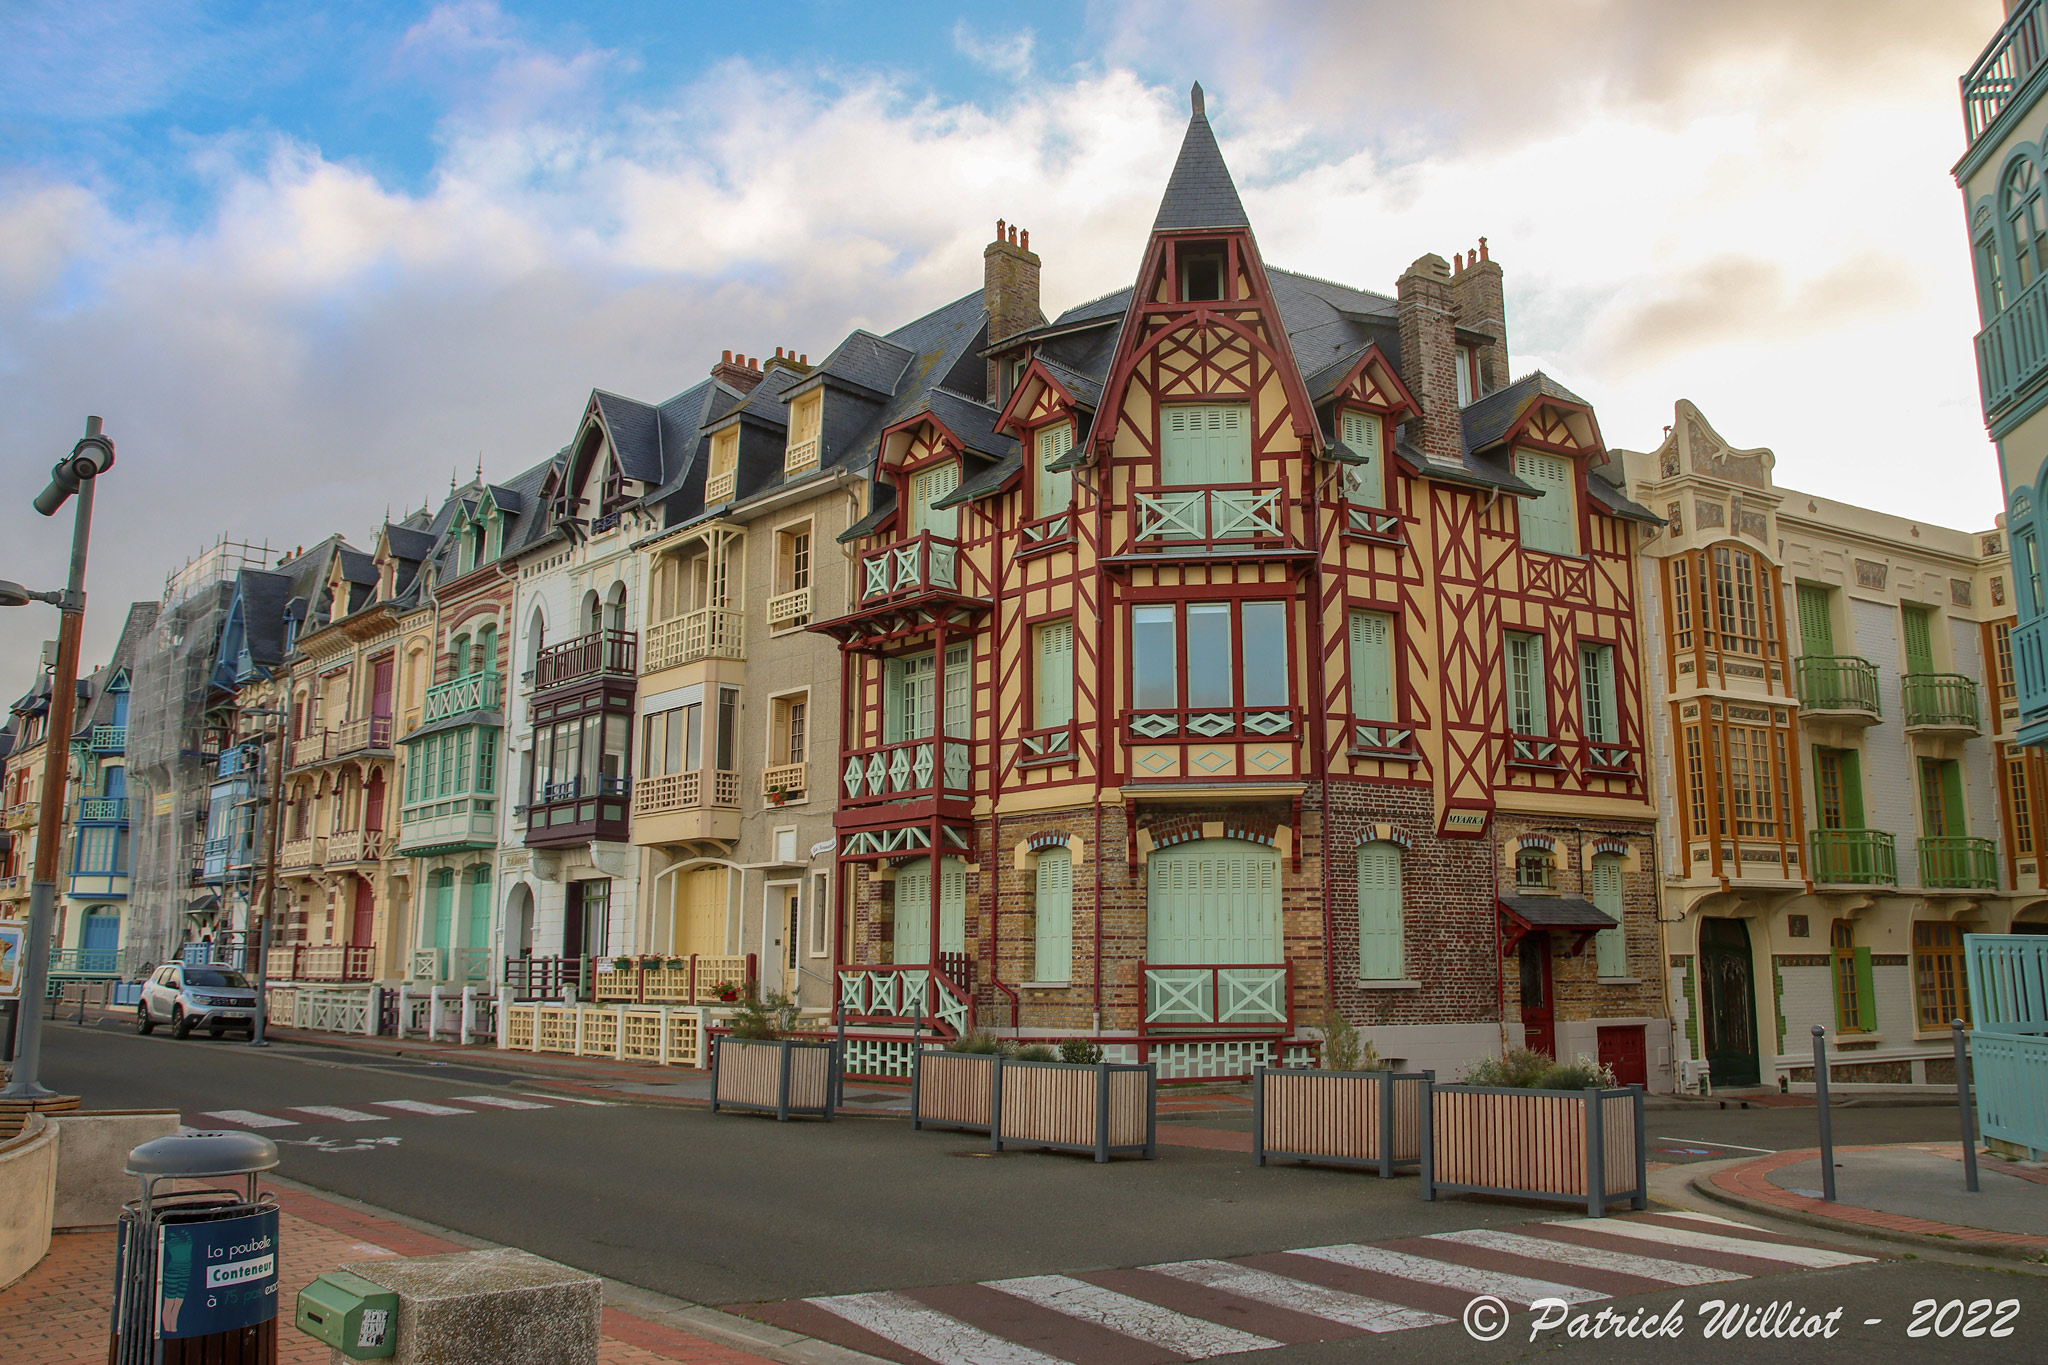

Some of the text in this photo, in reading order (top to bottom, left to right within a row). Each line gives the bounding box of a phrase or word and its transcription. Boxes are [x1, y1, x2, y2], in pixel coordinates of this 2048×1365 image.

[1448, 815, 1484, 825] MYARKA
[208, 1244, 224, 1259] La
[213, 1261, 272, 1282] Conteneur
[206, 1294, 217, 1308] à
[223, 1289, 238, 1305] 75
